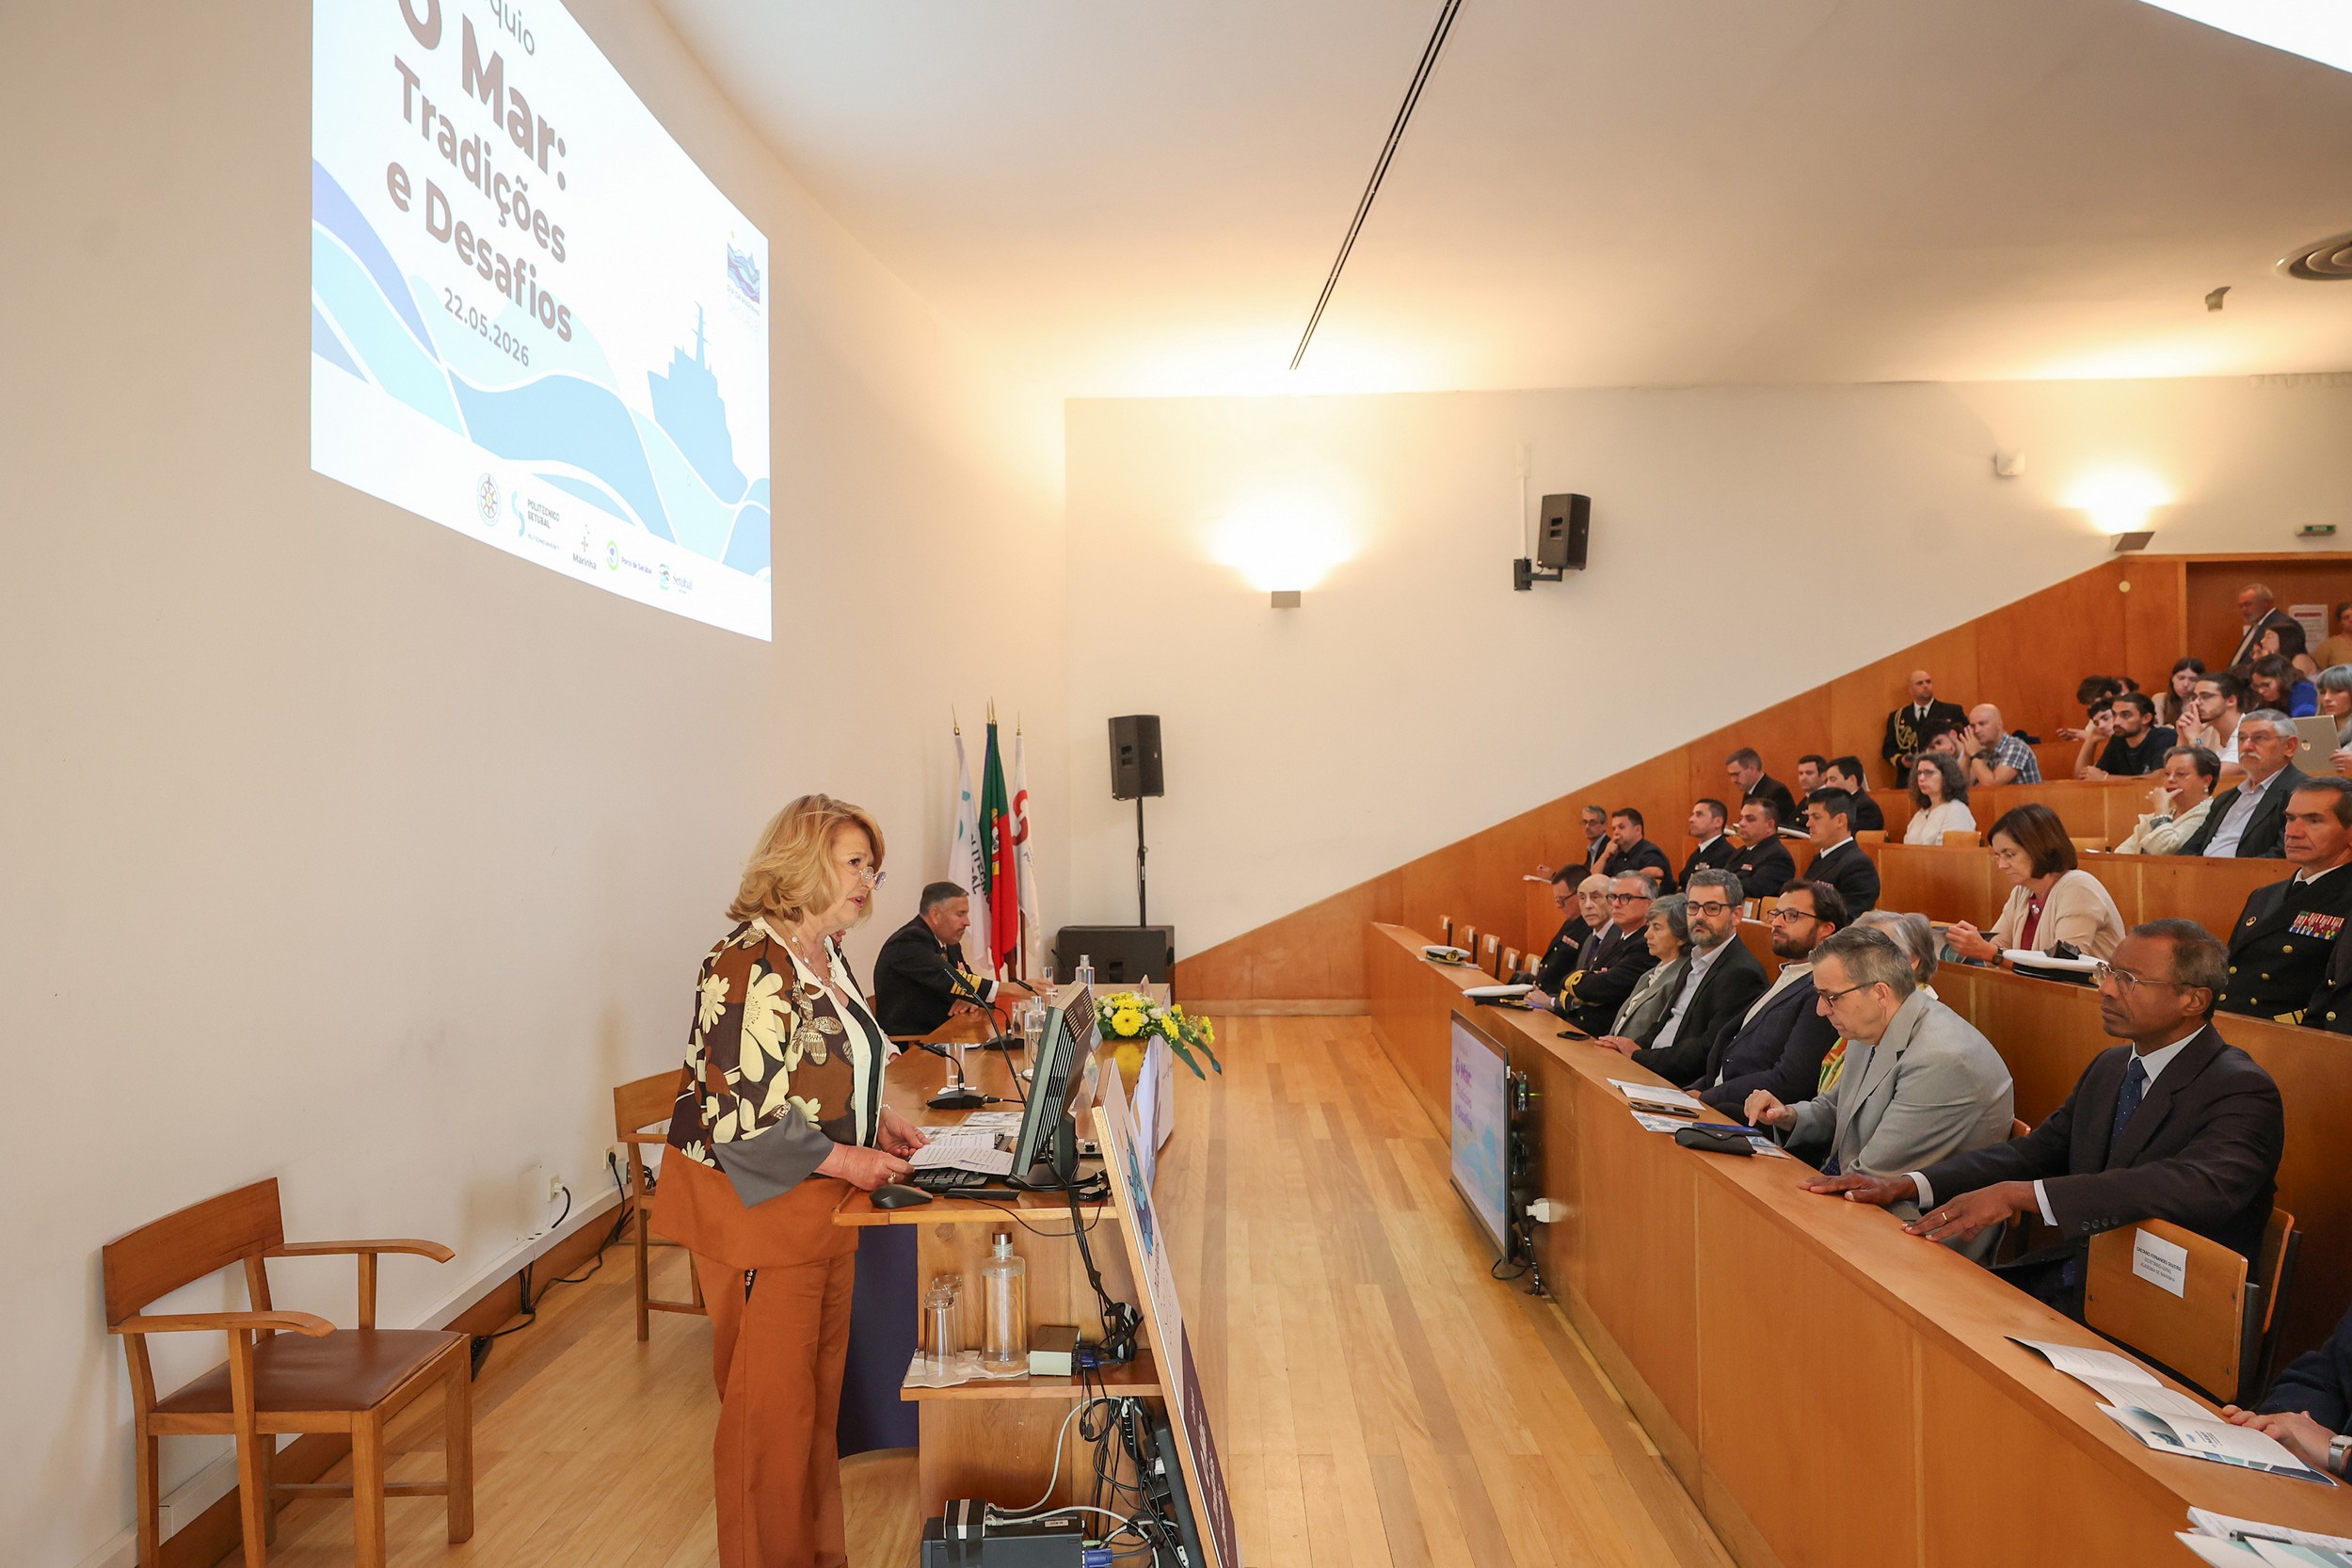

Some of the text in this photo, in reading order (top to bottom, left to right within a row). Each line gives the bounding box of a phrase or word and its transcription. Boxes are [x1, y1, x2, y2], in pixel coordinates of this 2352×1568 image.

[488, 0, 536, 56] quio
[393, 54, 568, 264] Tradições
[461, 12, 568, 193] Mar:
[386, 161, 572, 343] e Desafios
[444, 286, 530, 368] 22.05.2026
[572, 552, 597, 570] Marinha
